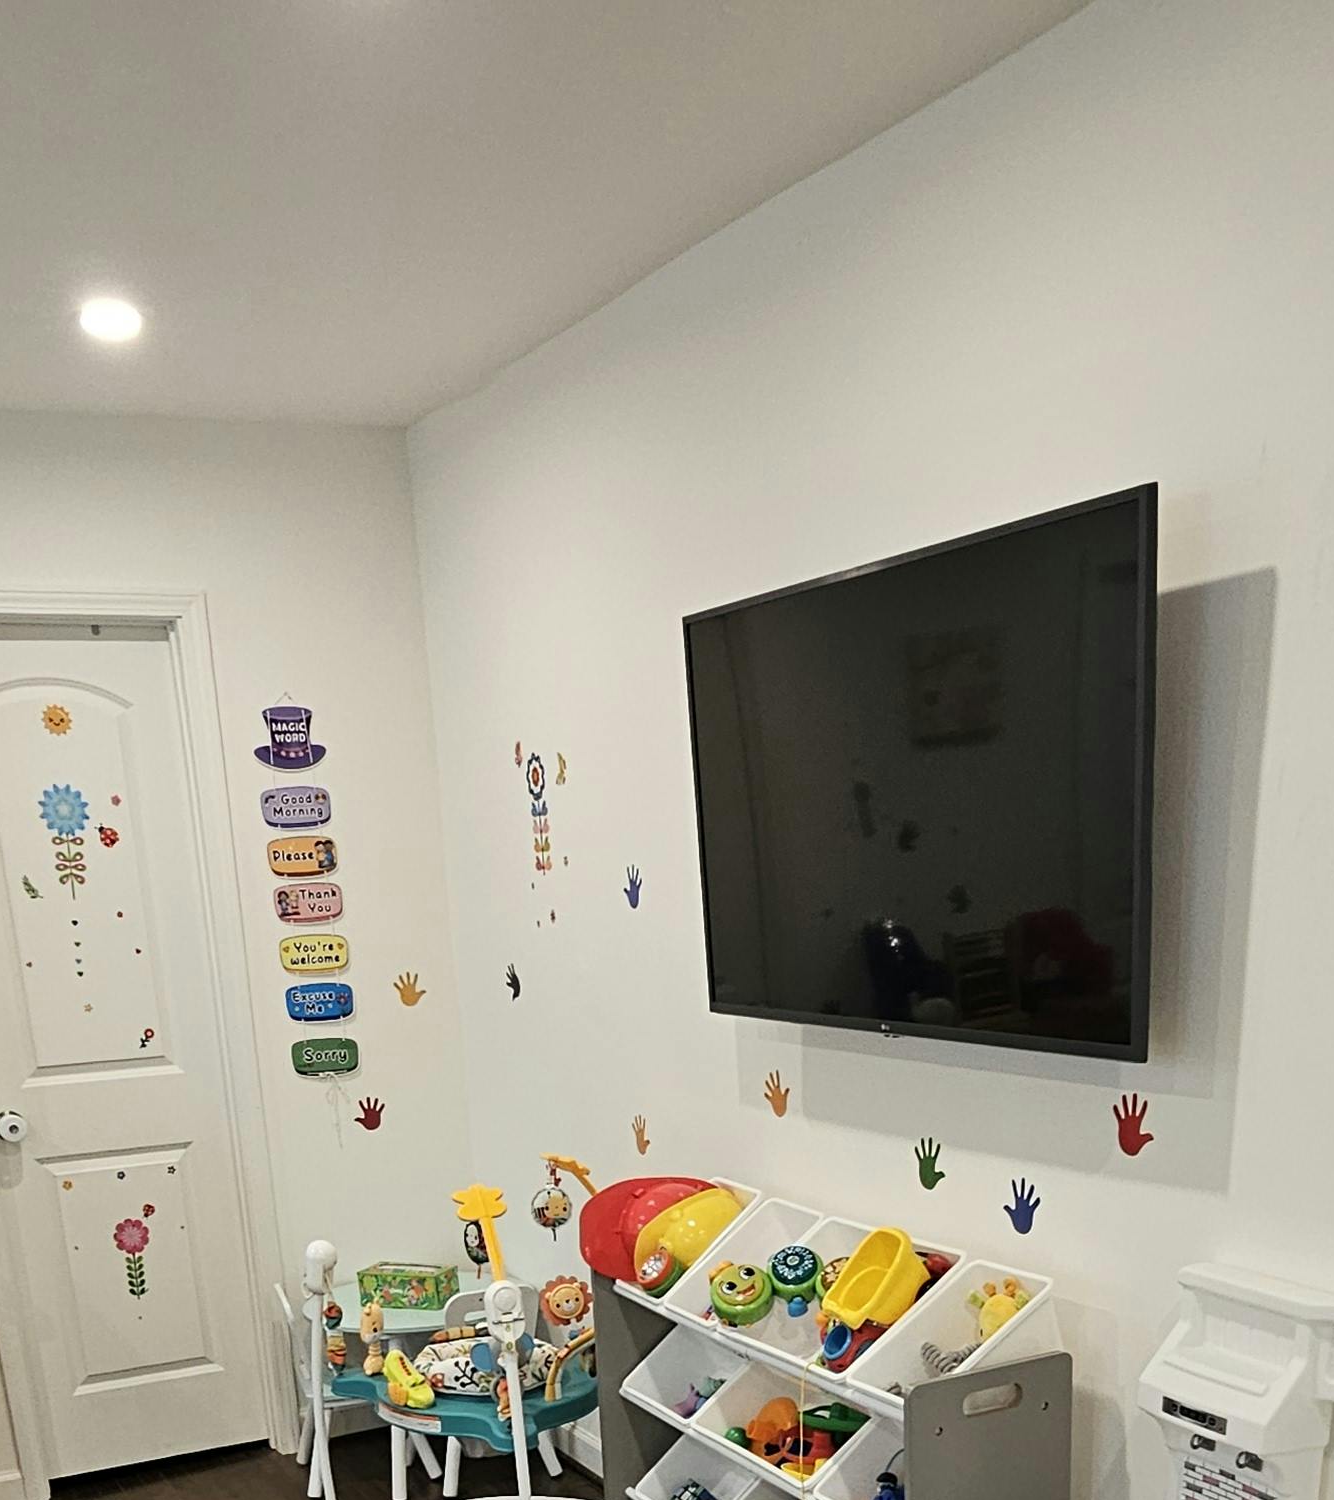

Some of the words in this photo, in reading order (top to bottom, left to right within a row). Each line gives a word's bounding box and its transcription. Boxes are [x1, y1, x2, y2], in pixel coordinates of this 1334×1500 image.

[272, 722, 306, 732] MAGIC
[274, 732, 306, 743] WORD
[280, 794, 312, 805] Good
[273, 806, 323, 818] Morning
[272, 849, 315, 862] Please
[299, 888, 337, 900] Thank
[307, 903, 332, 913] You
[293, 942, 334, 953] You're
[290, 954, 340, 966] welcome
[292, 990, 336, 1002] Excuse
[304, 1004, 325, 1014] Me
[303, 1048, 348, 1063] Sorry
